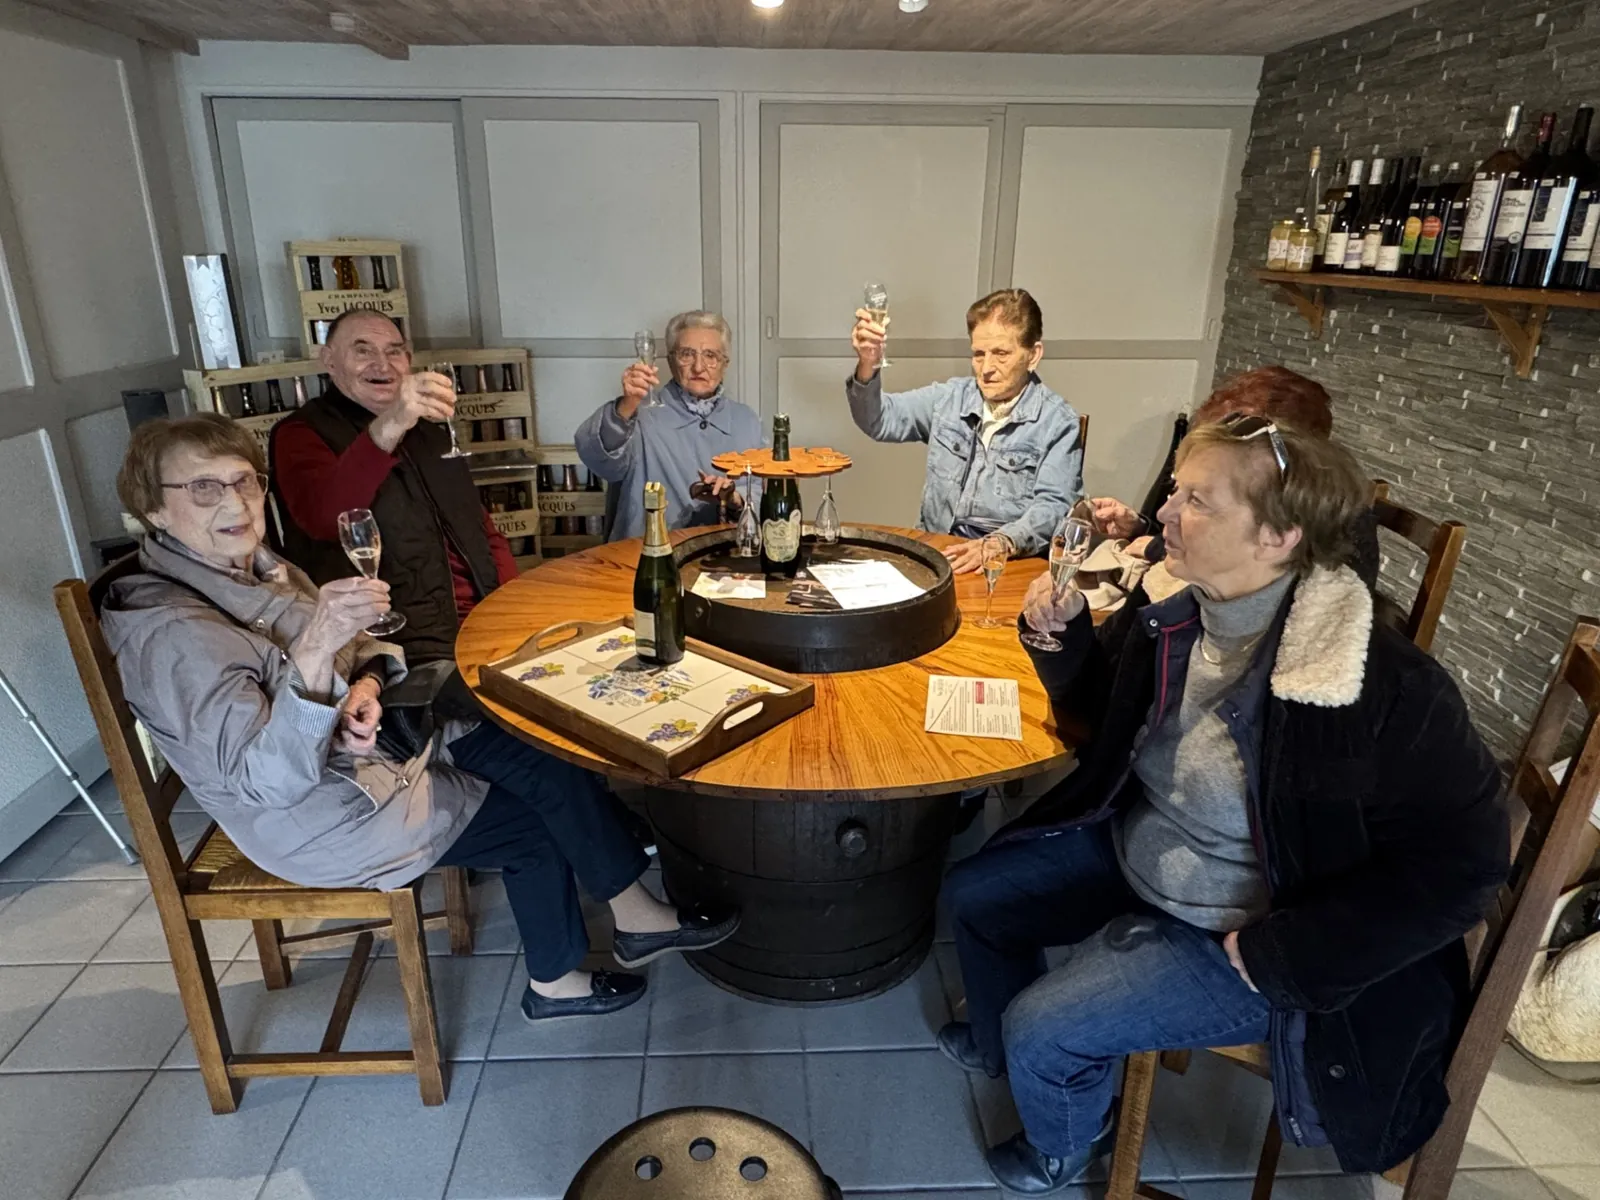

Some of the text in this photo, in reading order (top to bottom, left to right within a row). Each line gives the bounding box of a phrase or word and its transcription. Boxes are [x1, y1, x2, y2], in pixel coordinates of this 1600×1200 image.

[317, 300, 394, 314] Yves JACQUES
[455, 402, 497, 418] ACQUES
